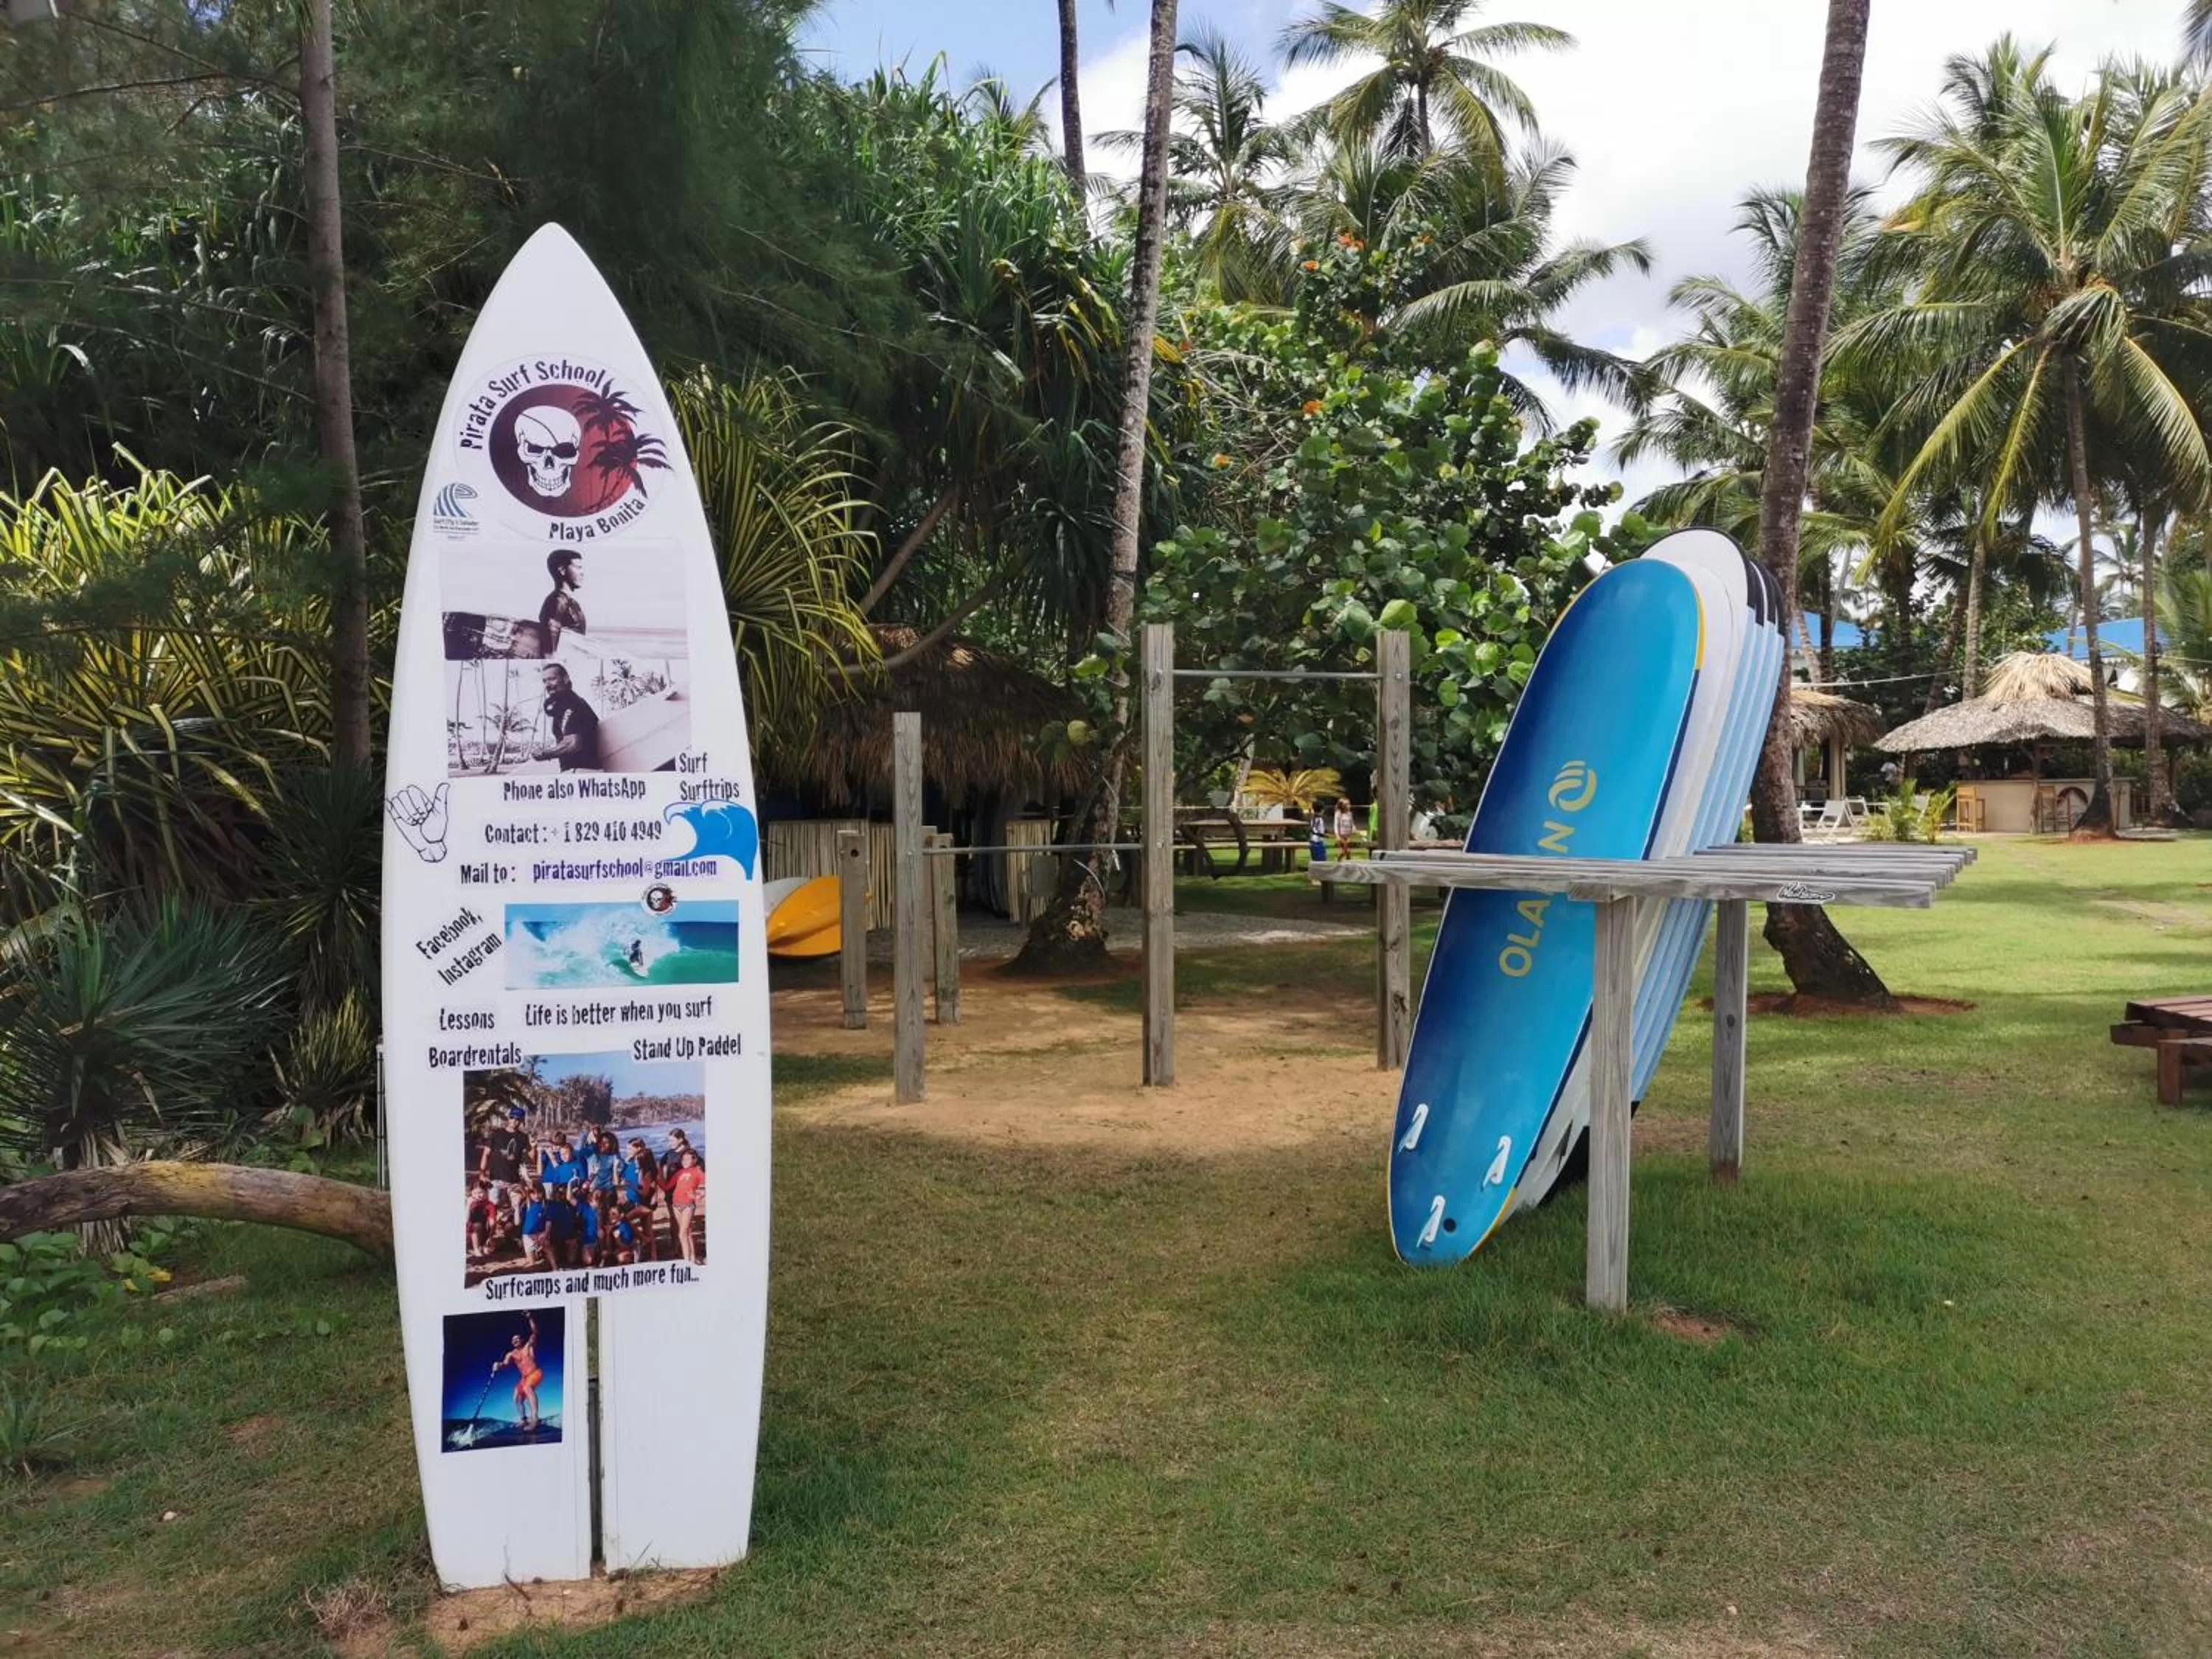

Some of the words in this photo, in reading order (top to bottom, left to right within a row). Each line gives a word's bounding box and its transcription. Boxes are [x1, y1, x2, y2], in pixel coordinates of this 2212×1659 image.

[459, 395, 497, 450] Pirata
[488, 364, 538, 398] Surf
[535, 359, 606, 389] School
[549, 521, 596, 543] Playa
[596, 498, 646, 534] Bonita
[678, 751, 708, 775] Surf
[503, 779, 543, 801] Phone
[547, 778, 574, 800] also
[577, 777, 647, 800] WhatsApp
[679, 778, 740, 802] Surftrips
[574, 821, 600, 843] 829
[603, 820, 627, 841] 410
[630, 820, 662, 841] 4949
[459, 862, 489, 884] Mail
[532, 857, 717, 884] piratasurfschool@gmail.com
[437, 933, 502, 986] Instagram
[439, 1007, 495, 1032] Lessons
[525, 1004, 552, 1027] Life
[556, 1004, 568, 1026] is
[571, 1002, 617, 1026] better
[619, 999, 654, 1023] when
[657, 1003, 682, 1024] you
[684, 995, 712, 1020] surf
[428, 1042, 522, 1068] Boardrentals
[633, 1037, 672, 1061] Stand
[675, 1036, 695, 1061] Up
[698, 1032, 742, 1057] Paddel
[485, 1277, 561, 1301] Surfcamps
[565, 1270, 590, 1294] and
[593, 1267, 630, 1293] much
[633, 1267, 666, 1287] more
